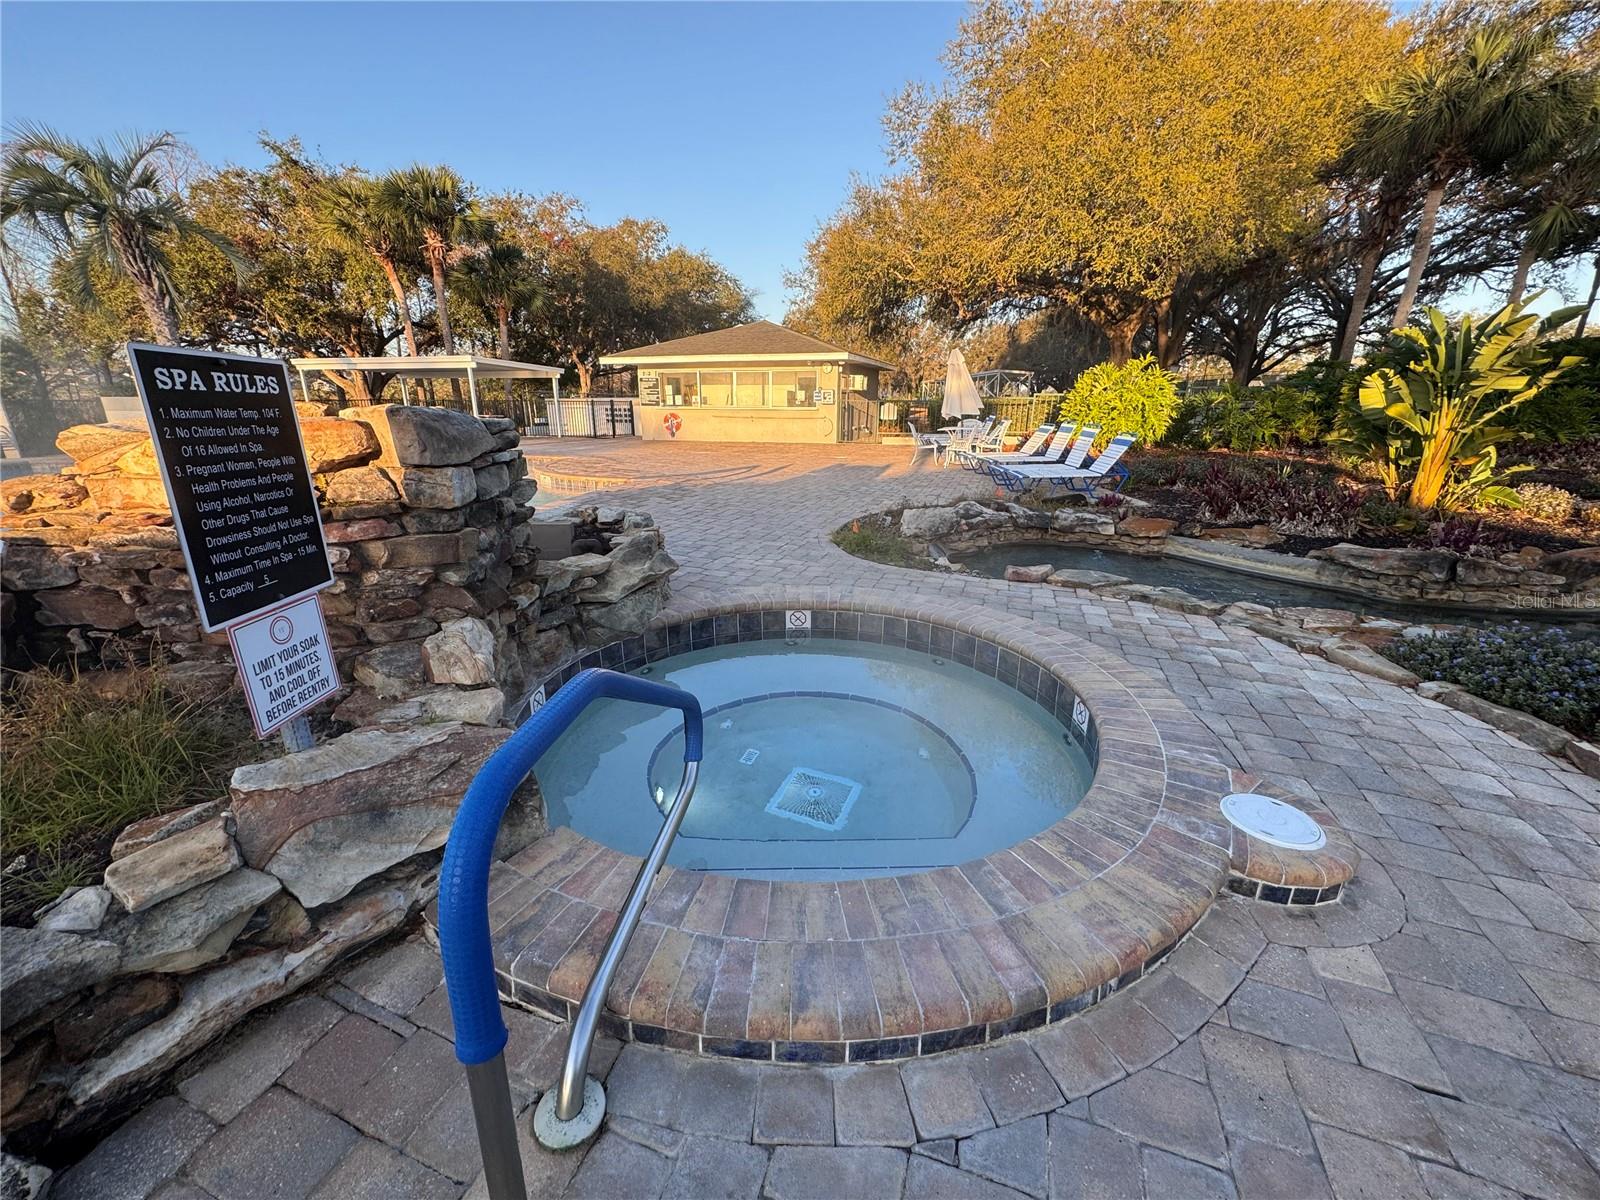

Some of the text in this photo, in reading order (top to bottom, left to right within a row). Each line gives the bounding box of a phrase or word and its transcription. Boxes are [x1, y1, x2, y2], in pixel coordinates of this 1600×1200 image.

[153, 367, 280, 395] SPA RULES
[159, 408, 169, 419] 1.
[170, 408, 213, 419] Maximum
[215, 408, 237, 418] Water
[238, 408, 261, 420] Temp.
[164, 425, 279, 439] 2. No Children Under The Age
[181, 442, 264, 457] Of 16 Allowed In Spa.
[174, 465, 184, 477] 3.
[186, 464, 225, 477] Pregnant
[258, 458, 281, 469] People
[281, 456, 296, 465] With
[191, 472, 294, 494] Health Problems And People
[195, 487, 294, 513] Using Alcohol, Narcotics Or
[201, 505, 289, 530] Other Drugs That Cause
[205, 514, 315, 548] Drowsiness Should Not Use Spa
[210, 532, 310, 565] Without Consulting A Doctor.
[204, 574, 214, 585] 4.
[215, 563, 253, 583] Maximum
[253, 559, 272, 570] Time
[272, 555, 280, 565] In
[280, 552, 293, 563] Spa
[297, 546, 306, 556] 15
[208, 591, 219, 603] 5.
[219, 580, 254, 599] Capacity
[252, 634, 321, 677] LIMIT YOUR SOAK
[259, 674, 273, 690] TO
[274, 668, 285, 683] 15
[269, 665, 321, 704] AND COOL OFF
[265, 675, 330, 723] BEFORE REENTRY
